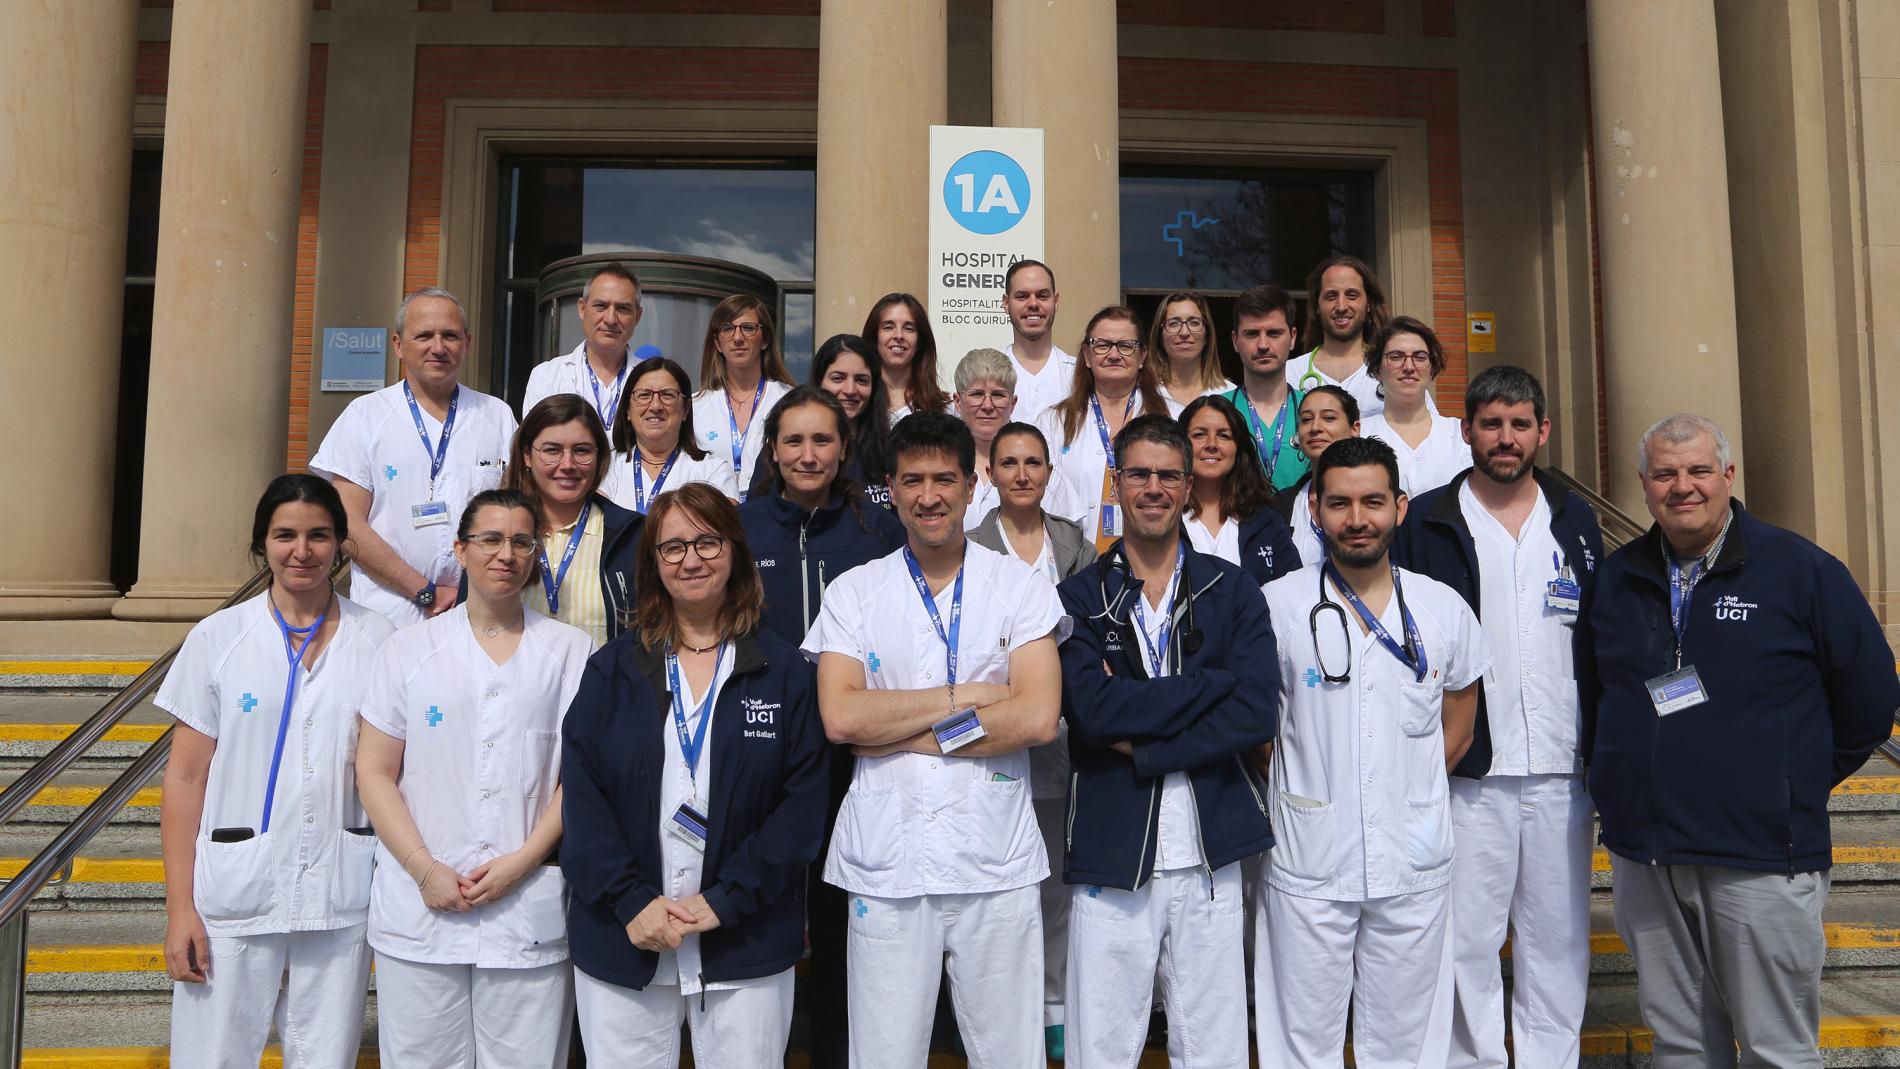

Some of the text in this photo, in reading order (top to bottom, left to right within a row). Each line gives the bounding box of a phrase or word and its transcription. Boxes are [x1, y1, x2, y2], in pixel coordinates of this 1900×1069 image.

[954, 173, 1021, 214] 1A
[942, 273, 1005, 289] GENER
[942, 299, 1004, 309] HOSPITALITZ
[942, 314, 1013, 325] BLOC QUIRÚR
[1715, 607, 1748, 621] UCI
[746, 710, 774, 724] UCI
